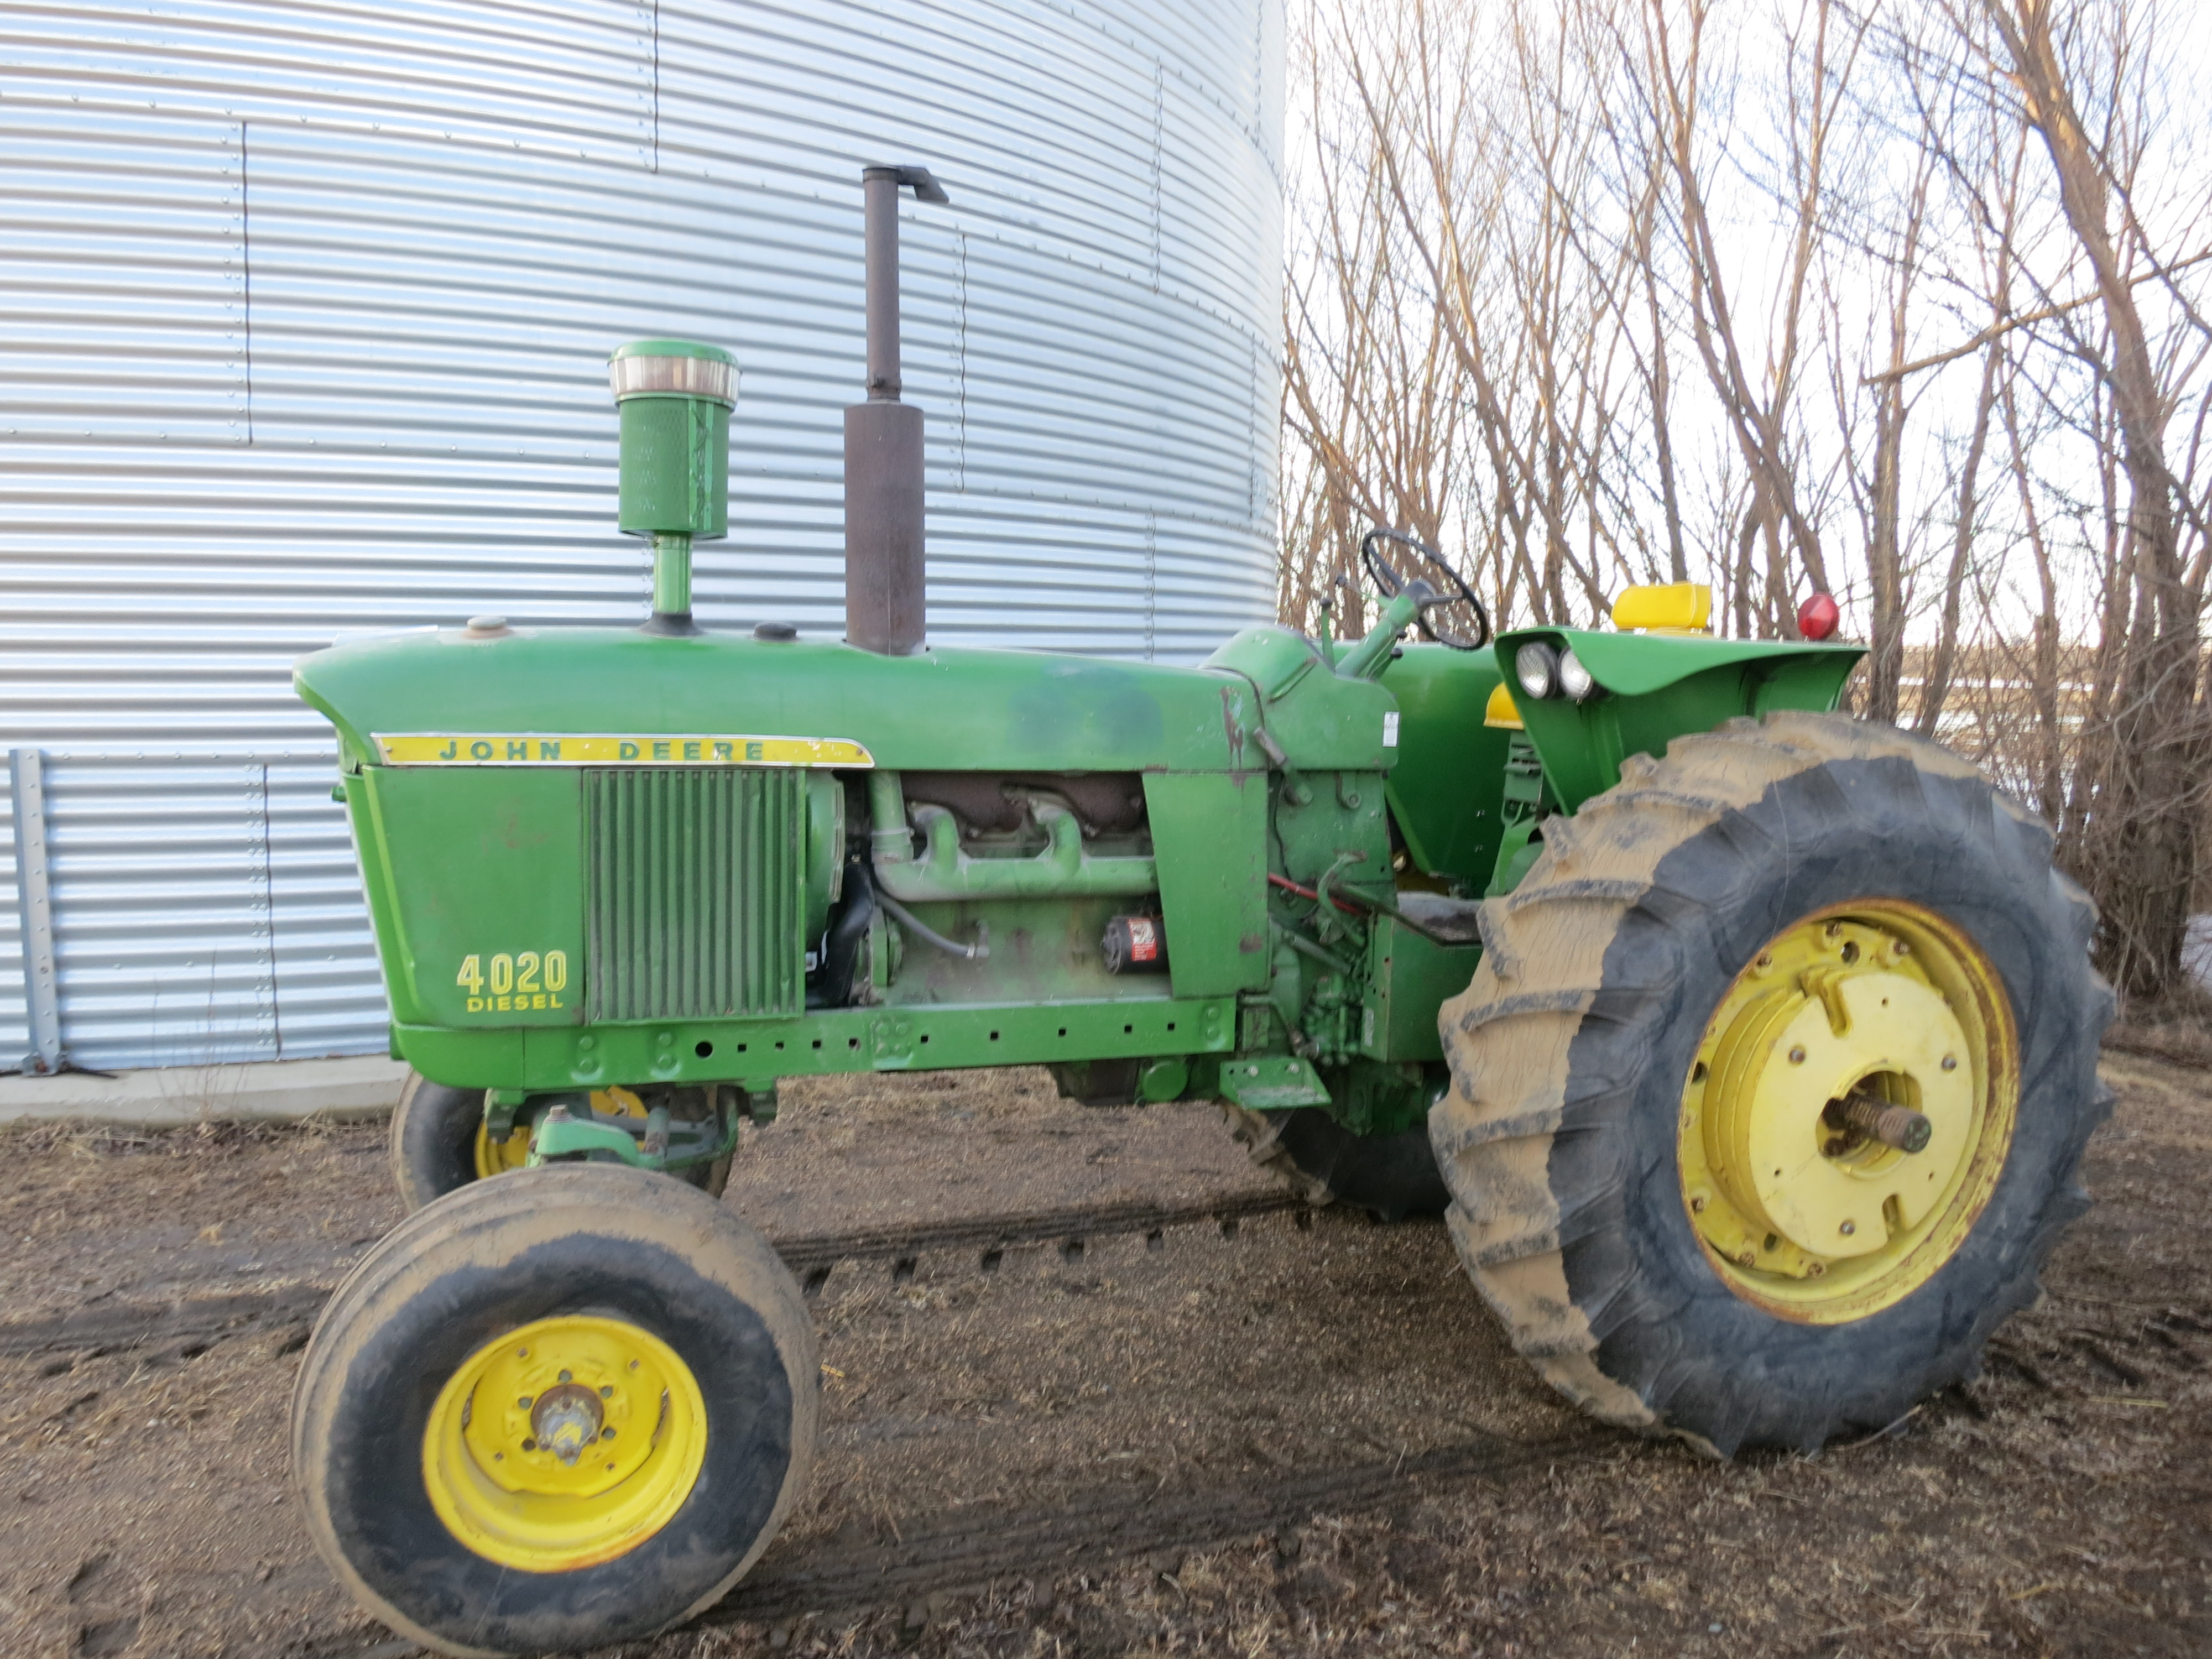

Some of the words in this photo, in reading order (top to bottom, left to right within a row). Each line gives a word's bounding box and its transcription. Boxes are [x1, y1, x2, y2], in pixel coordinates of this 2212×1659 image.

[439, 740, 561, 761] JOHN
[619, 740, 764, 760] DEERE
[457, 950, 567, 995] 4020
[467, 993, 563, 1012] DIESEL
